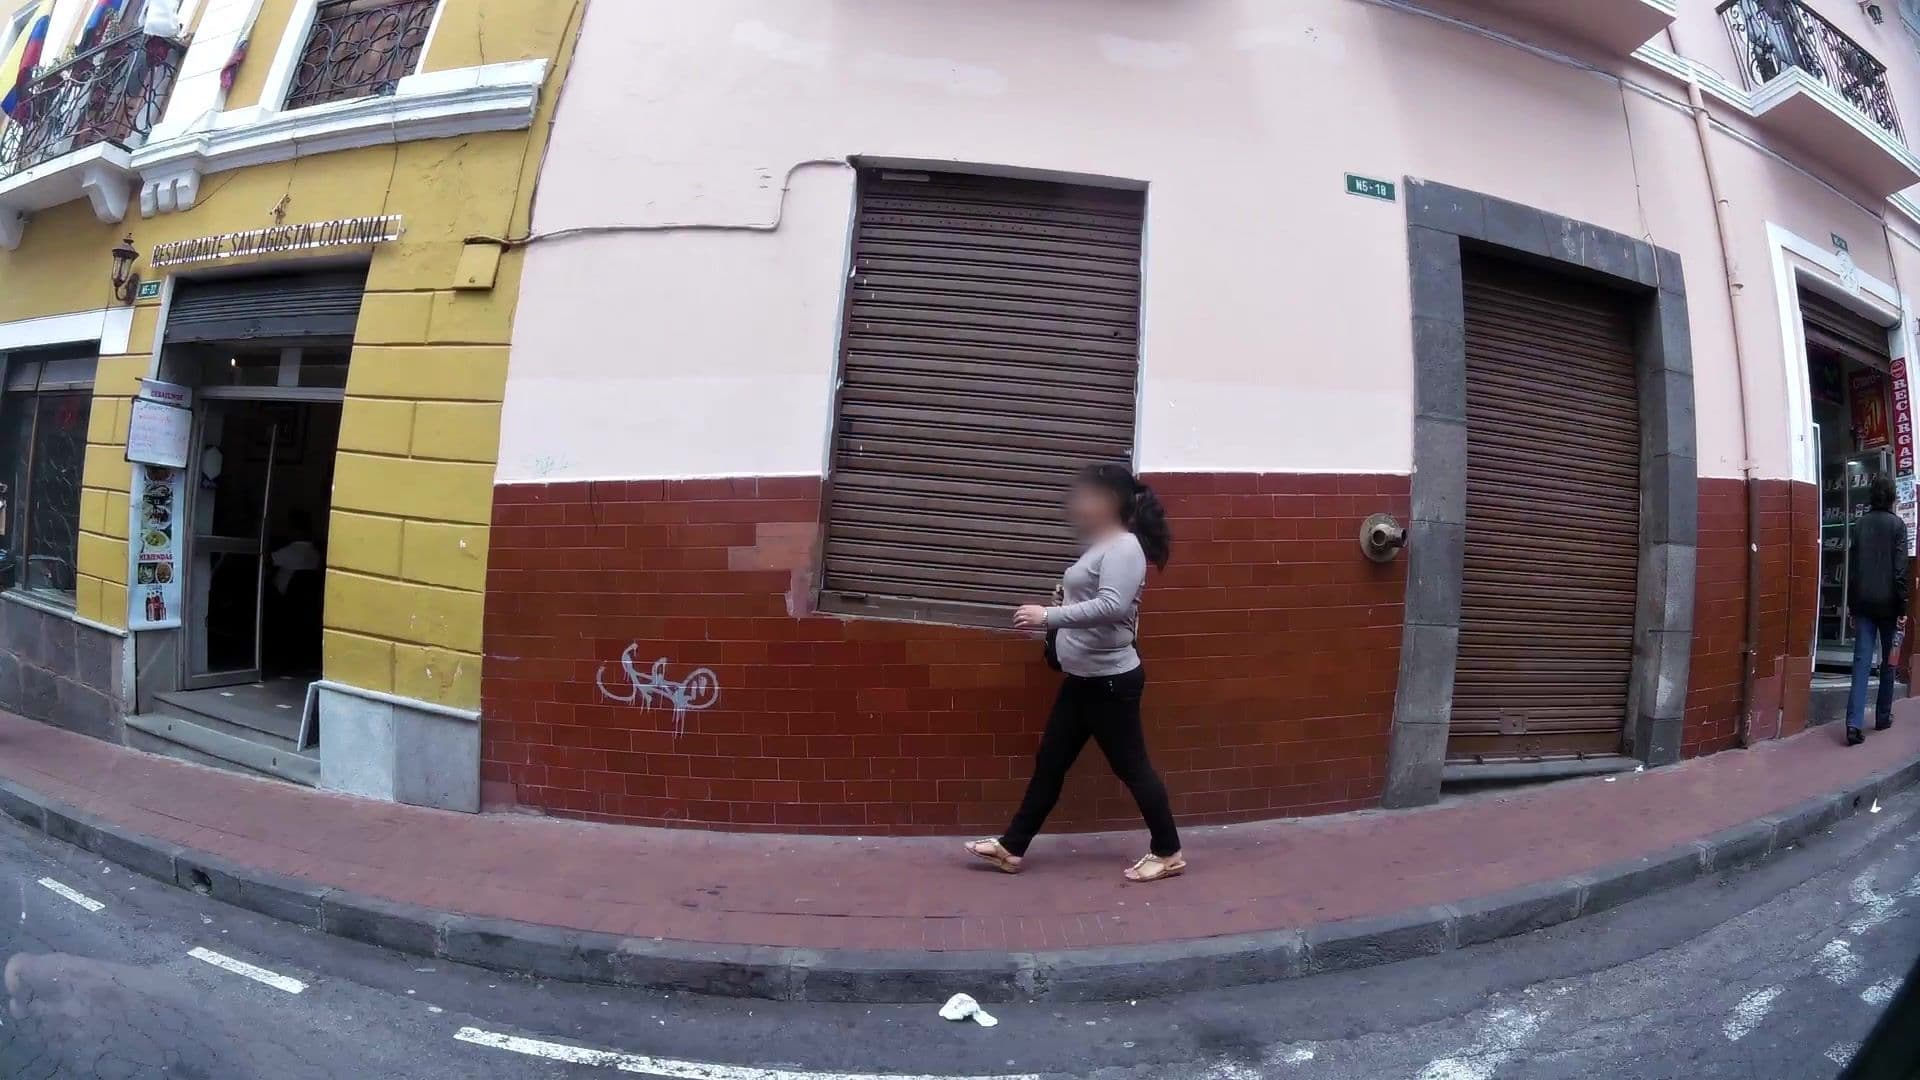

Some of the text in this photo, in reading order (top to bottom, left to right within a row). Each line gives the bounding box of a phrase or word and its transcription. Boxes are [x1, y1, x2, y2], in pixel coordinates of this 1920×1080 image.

[152, 215, 390, 265] RESTAURANTE SAN AGUSTIN COLONIAL
[1893, 378, 1913, 468] RECARGAS
[138, 553, 174, 561] MERIENDAS
